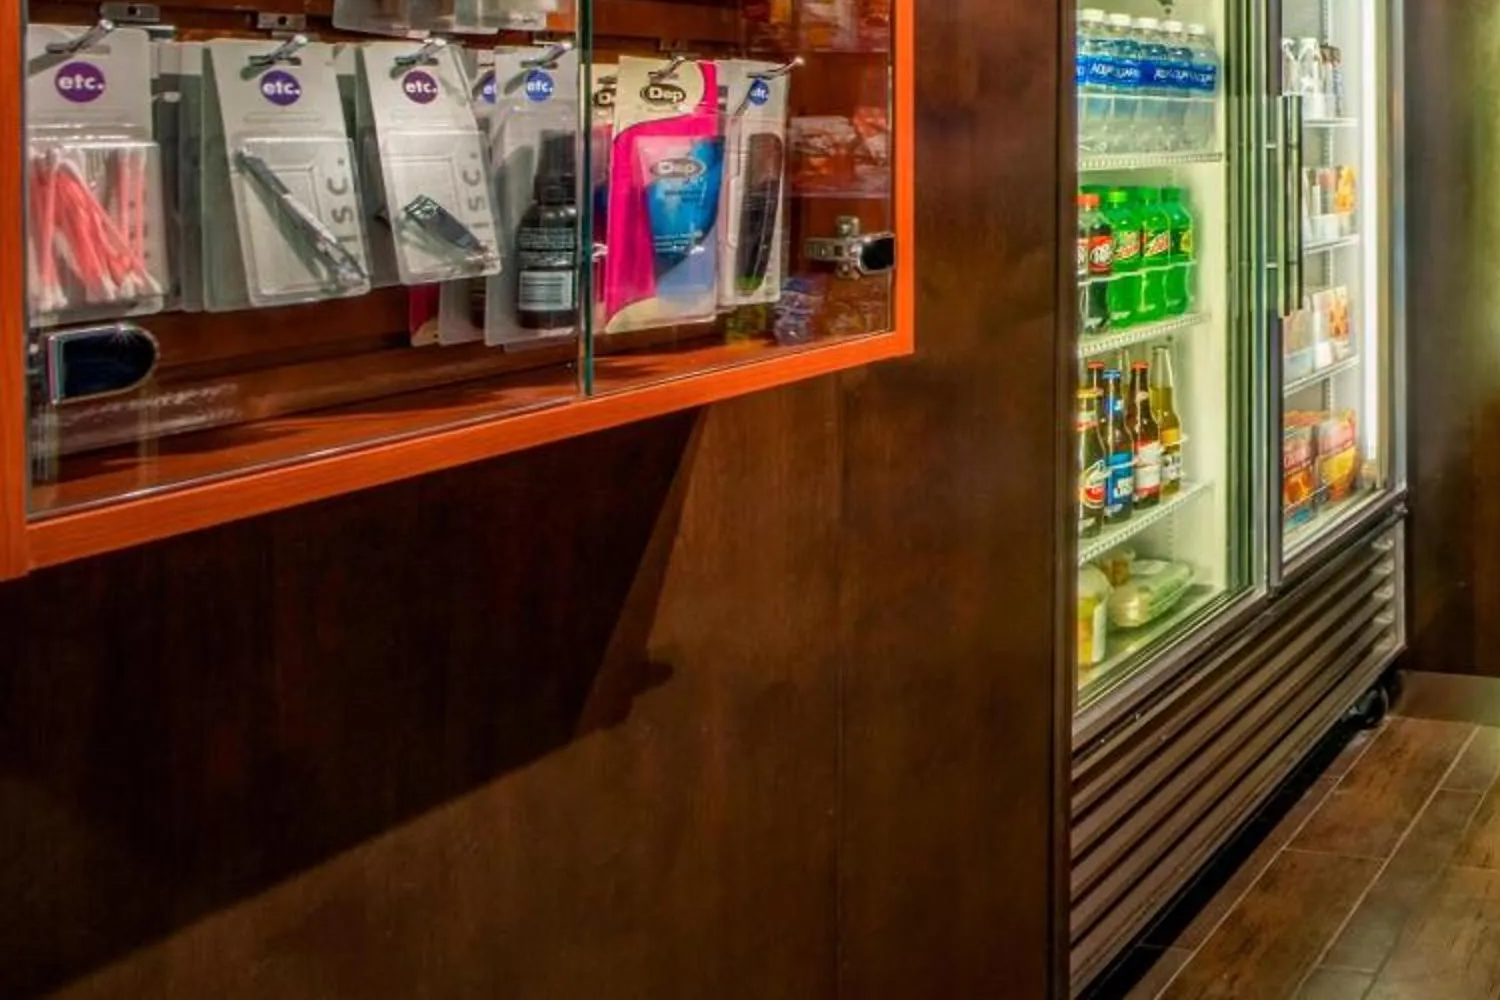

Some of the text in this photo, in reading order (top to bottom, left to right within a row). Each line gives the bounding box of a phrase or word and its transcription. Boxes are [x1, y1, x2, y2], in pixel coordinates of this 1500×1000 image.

[58, 73, 106, 92] etc.
[262, 80, 301, 96] etc.
[405, 81, 438, 94] etc.
[526, 79, 554, 94] etc.
[650, 86, 683, 104] Dep
